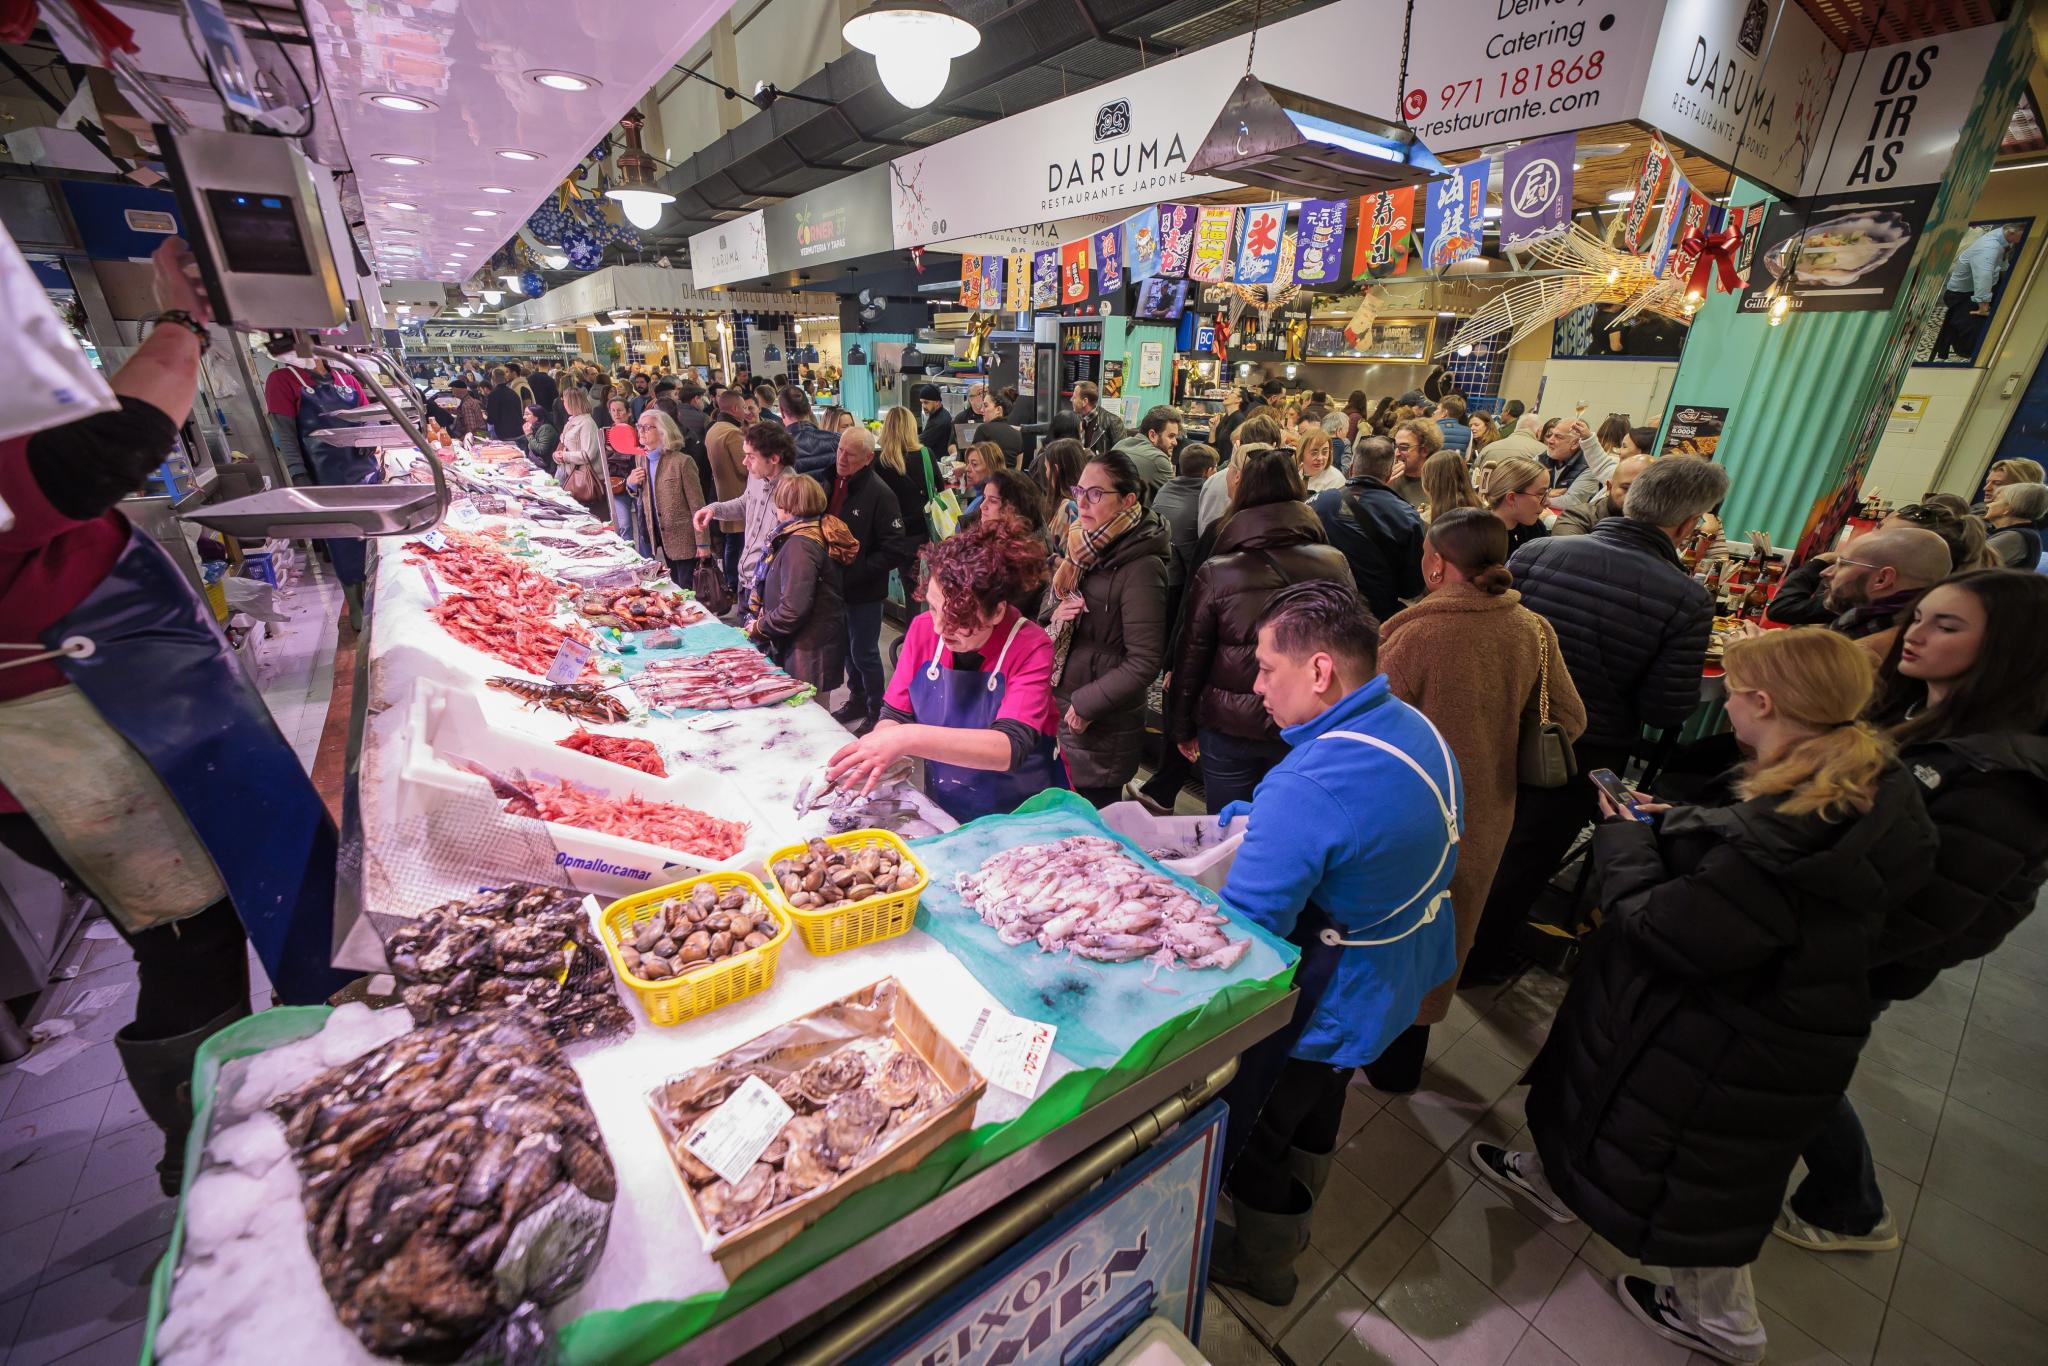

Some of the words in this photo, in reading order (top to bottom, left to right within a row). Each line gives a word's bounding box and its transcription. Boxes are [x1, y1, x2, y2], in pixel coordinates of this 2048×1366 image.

[1498, 0, 1584, 20] Deli
[1486, 20, 1586, 59] Catering
[1441, 77, 1483, 111] 971
[1500, 50, 1605, 98] 181868
[1686, 35, 1776, 135] DARUMA
[1880, 45, 1940, 95] OS
[1409, 90, 1600, 138] a-restaurante.com
[1672, 92, 1736, 142] RESTAURANTE
[1867, 95, 1918, 141] TR
[1048, 132, 1187, 193] DARUMA
[1846, 140, 1904, 186] AS
[1041, 184, 1125, 211] RESTAURANTE
[972, 235, 1027, 245] ESTAURANTE
[1371, 190, 1395, 265] 寿司
[1200, 331, 1214, 345] BC
[555, 851, 652, 882] Opmallorcamar
[921, 1243, 1081, 1366] EIXOS
[984, 1224, 1150, 1366] MEN
